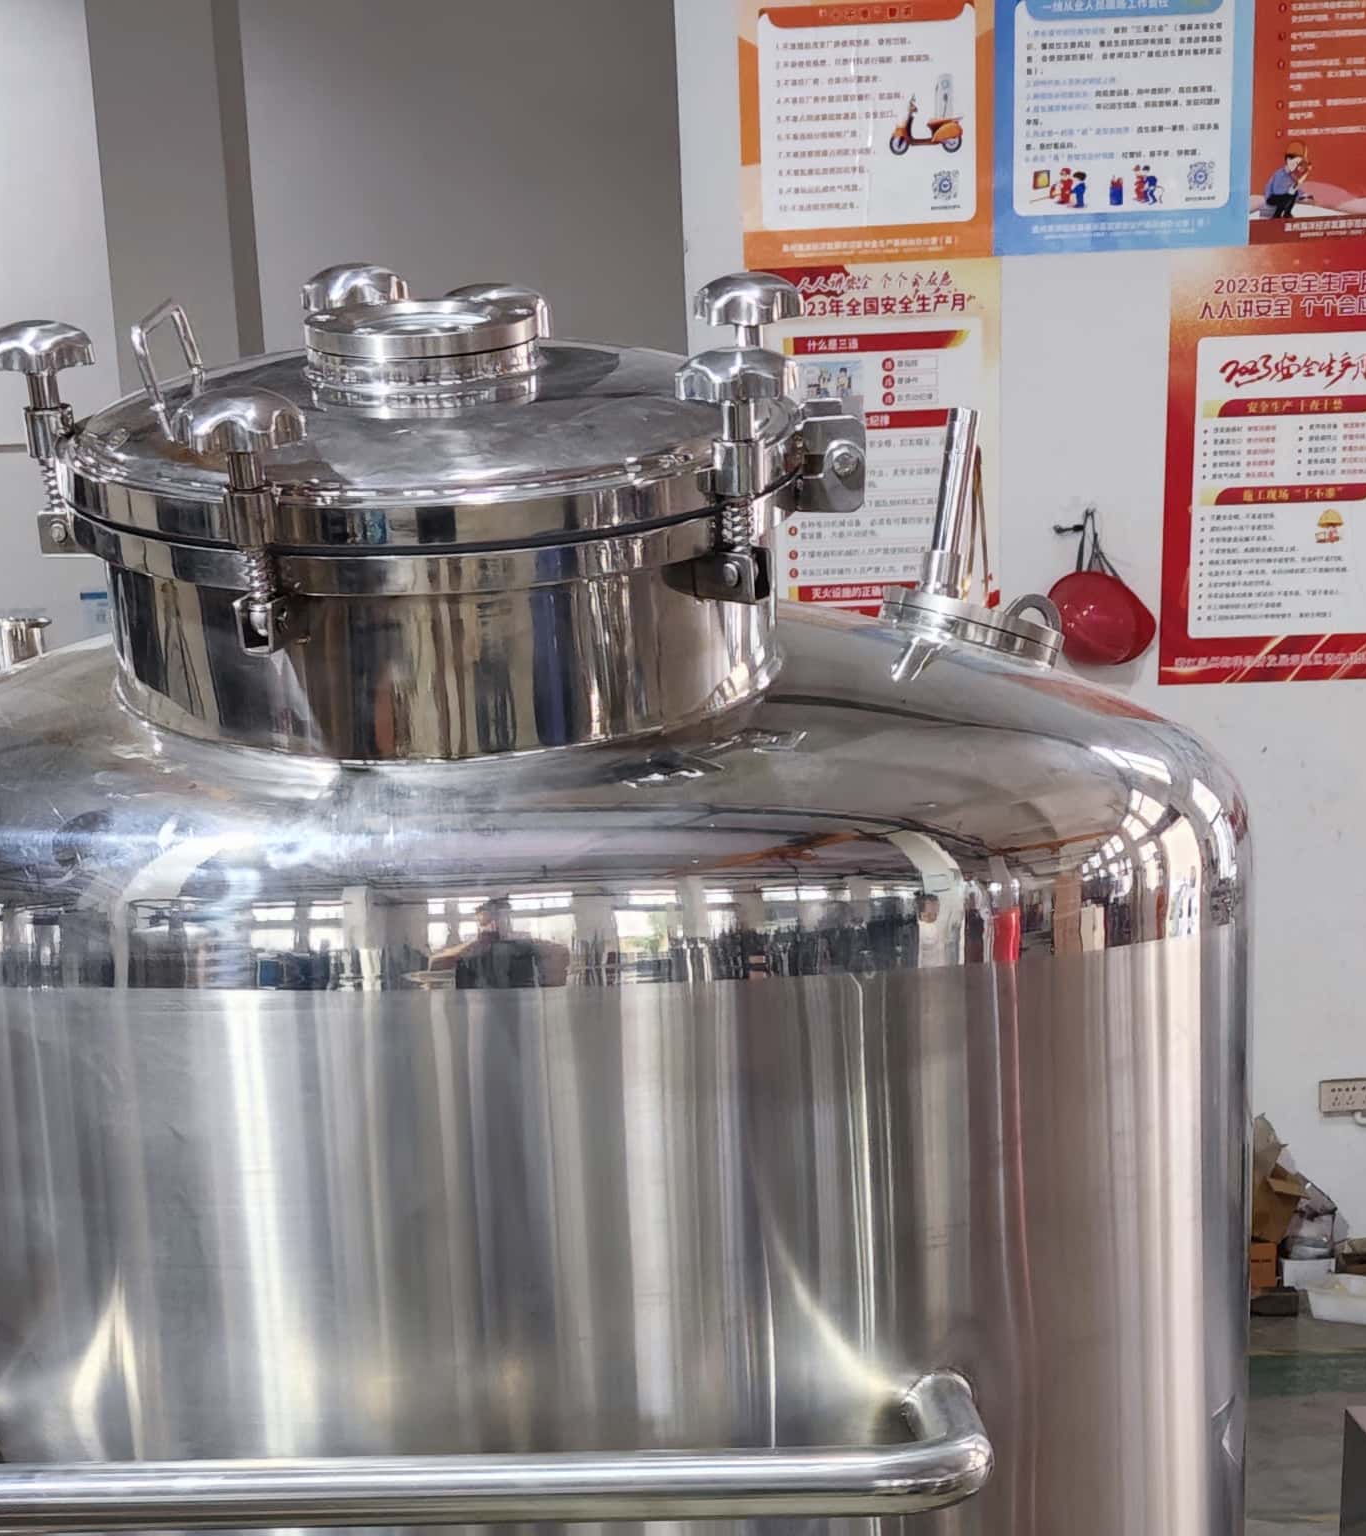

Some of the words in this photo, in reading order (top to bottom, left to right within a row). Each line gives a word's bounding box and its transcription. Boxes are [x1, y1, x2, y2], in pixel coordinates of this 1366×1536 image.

[802, 293, 966, 318] 23年全国安全生产月
[1199, 296, 1292, 320] 人人讲安全
[811, 585, 884, 600] 灭火设施的正确
